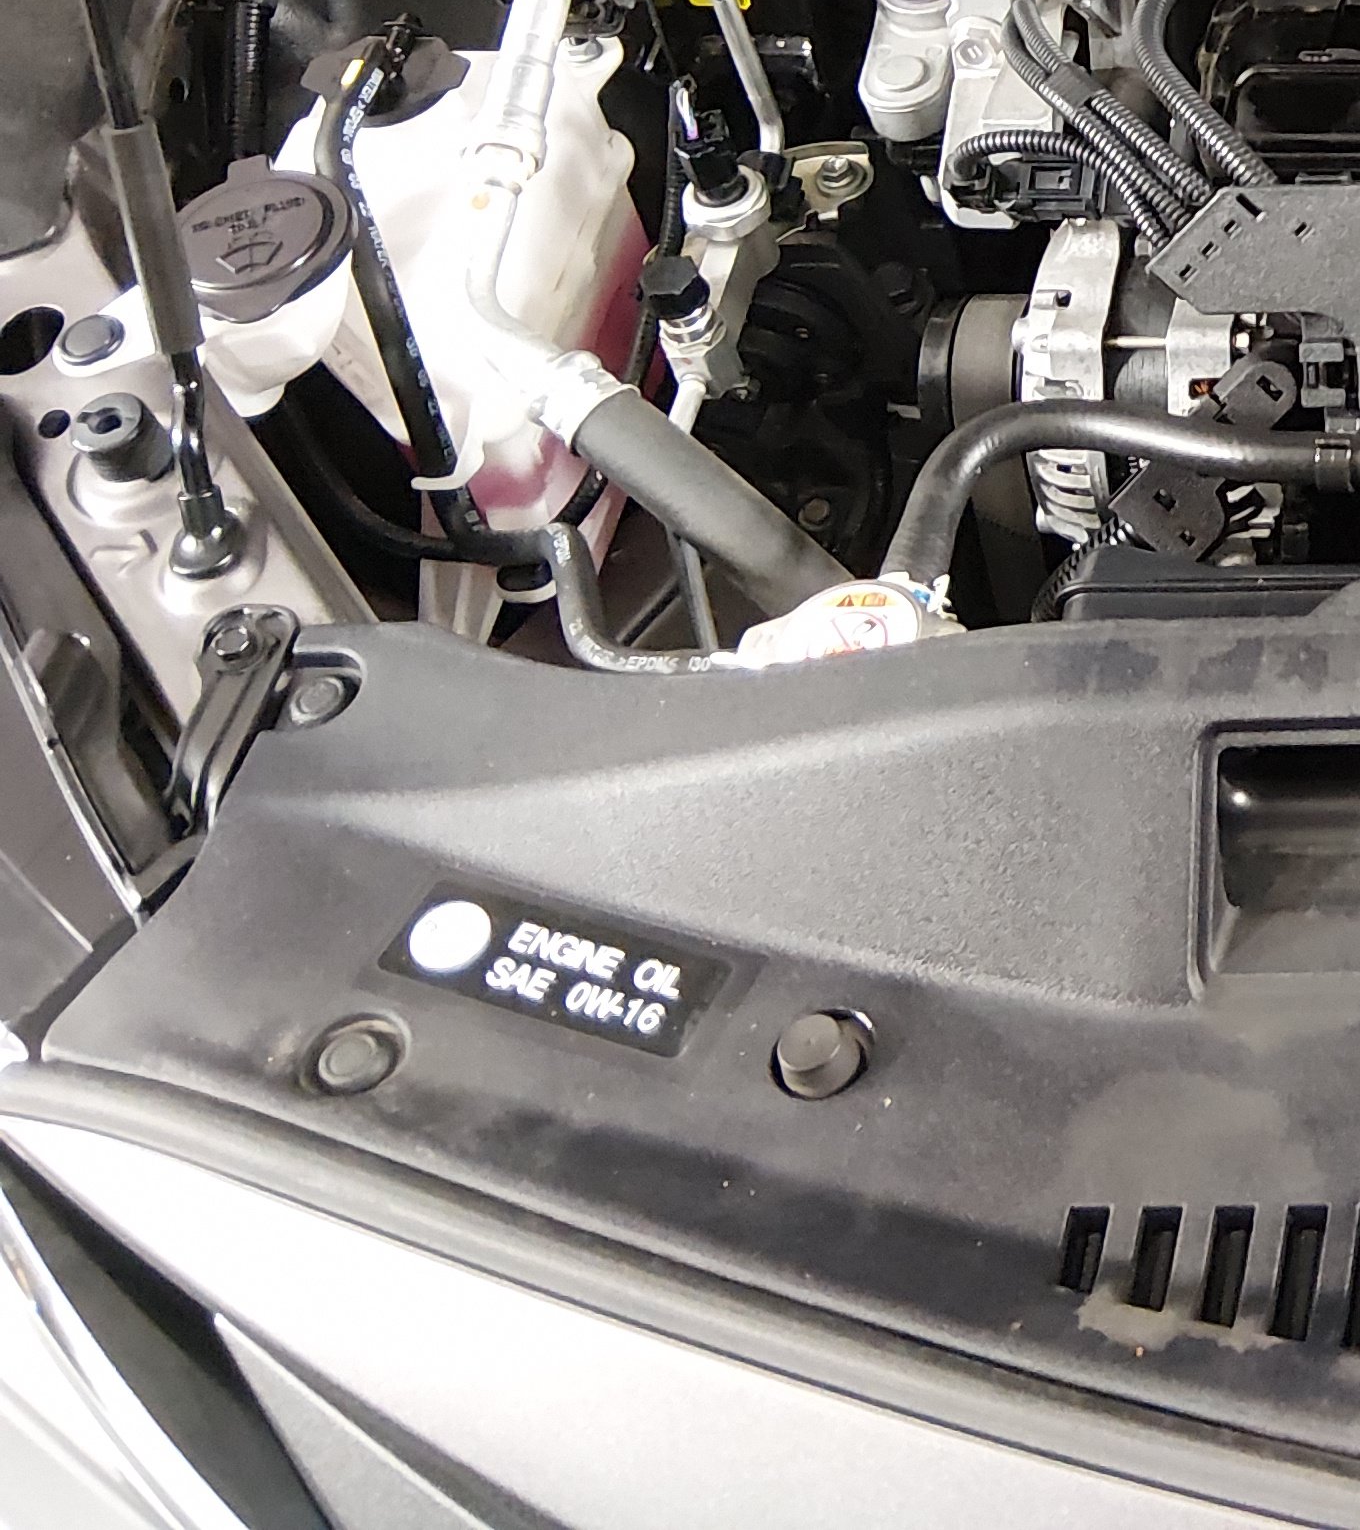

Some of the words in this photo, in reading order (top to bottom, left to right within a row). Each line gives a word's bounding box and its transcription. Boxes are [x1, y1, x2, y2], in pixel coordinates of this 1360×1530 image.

[485, 956, 557, 1002] SAE
[565, 980, 667, 1035] 0W-16
[508, 921, 626, 980] ENGINE
[634, 958, 681, 1000] OIL
